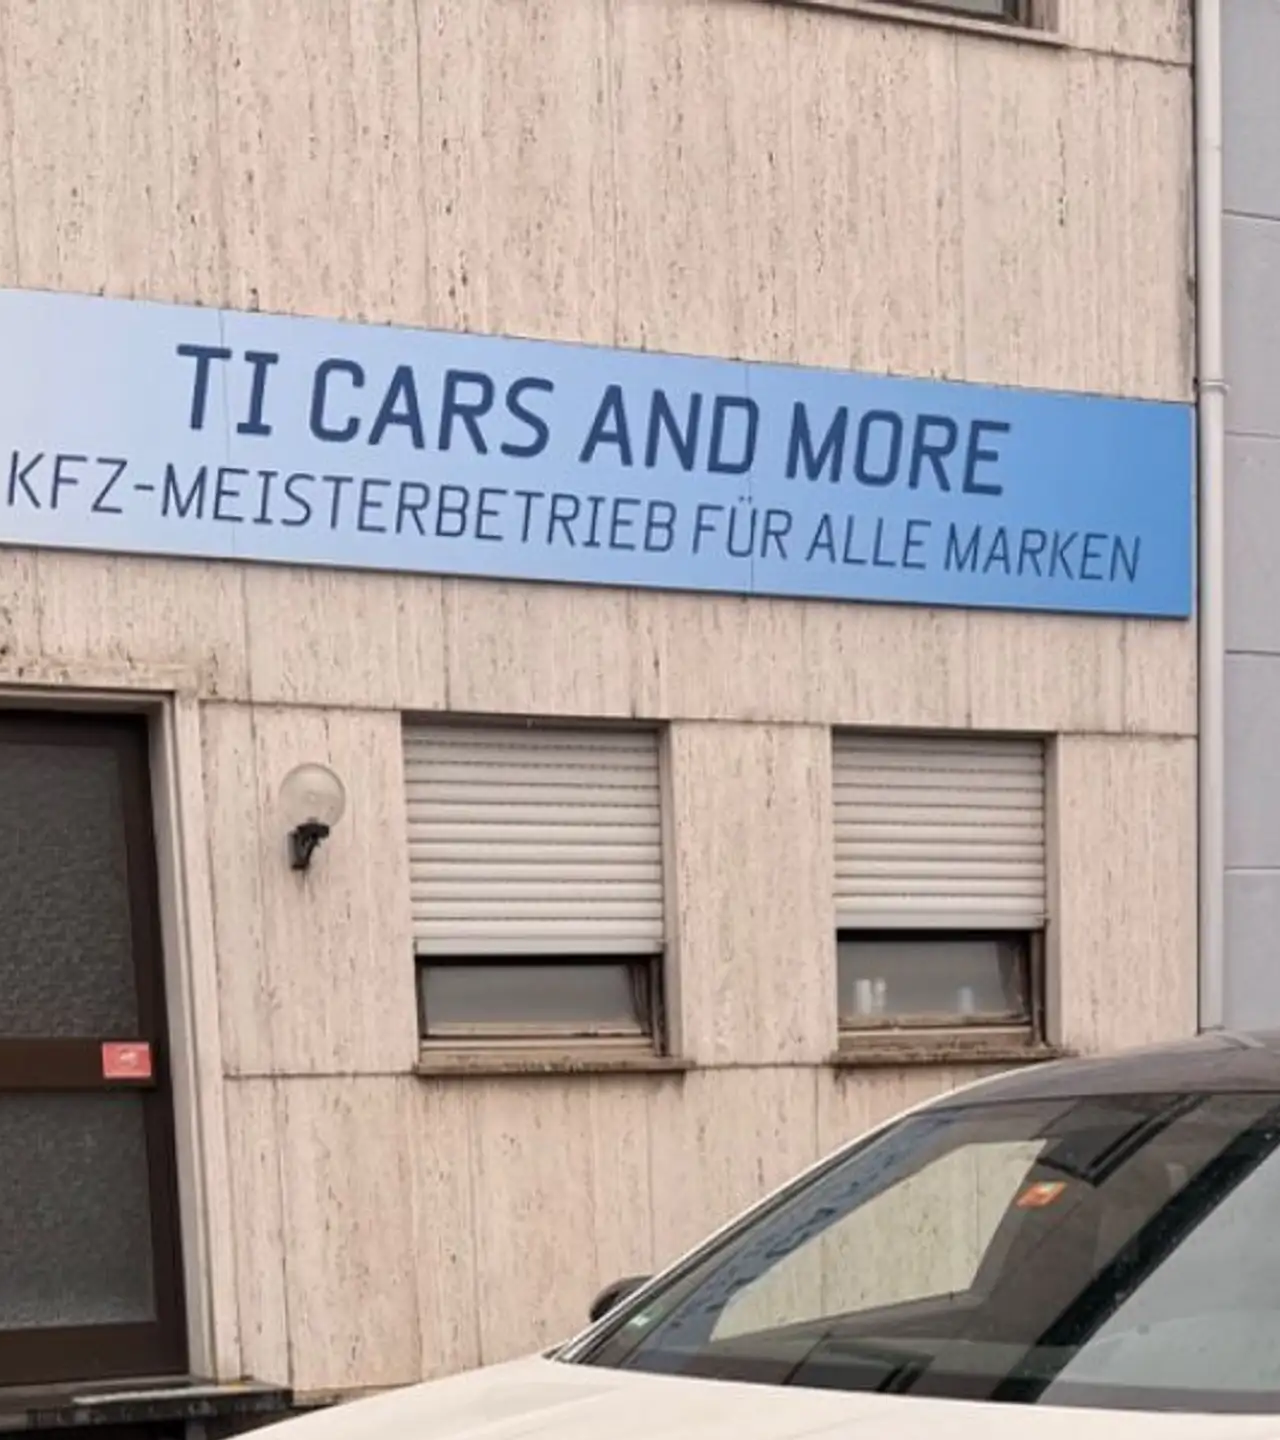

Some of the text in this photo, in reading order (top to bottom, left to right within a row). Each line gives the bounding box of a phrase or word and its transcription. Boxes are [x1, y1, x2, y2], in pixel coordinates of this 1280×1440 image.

[176, 343, 1012, 497] TI CARS AND MORE
[6, 449, 1142, 585] KFZ-MEISTERBETRIEB FÜR ALLE MARKEN
